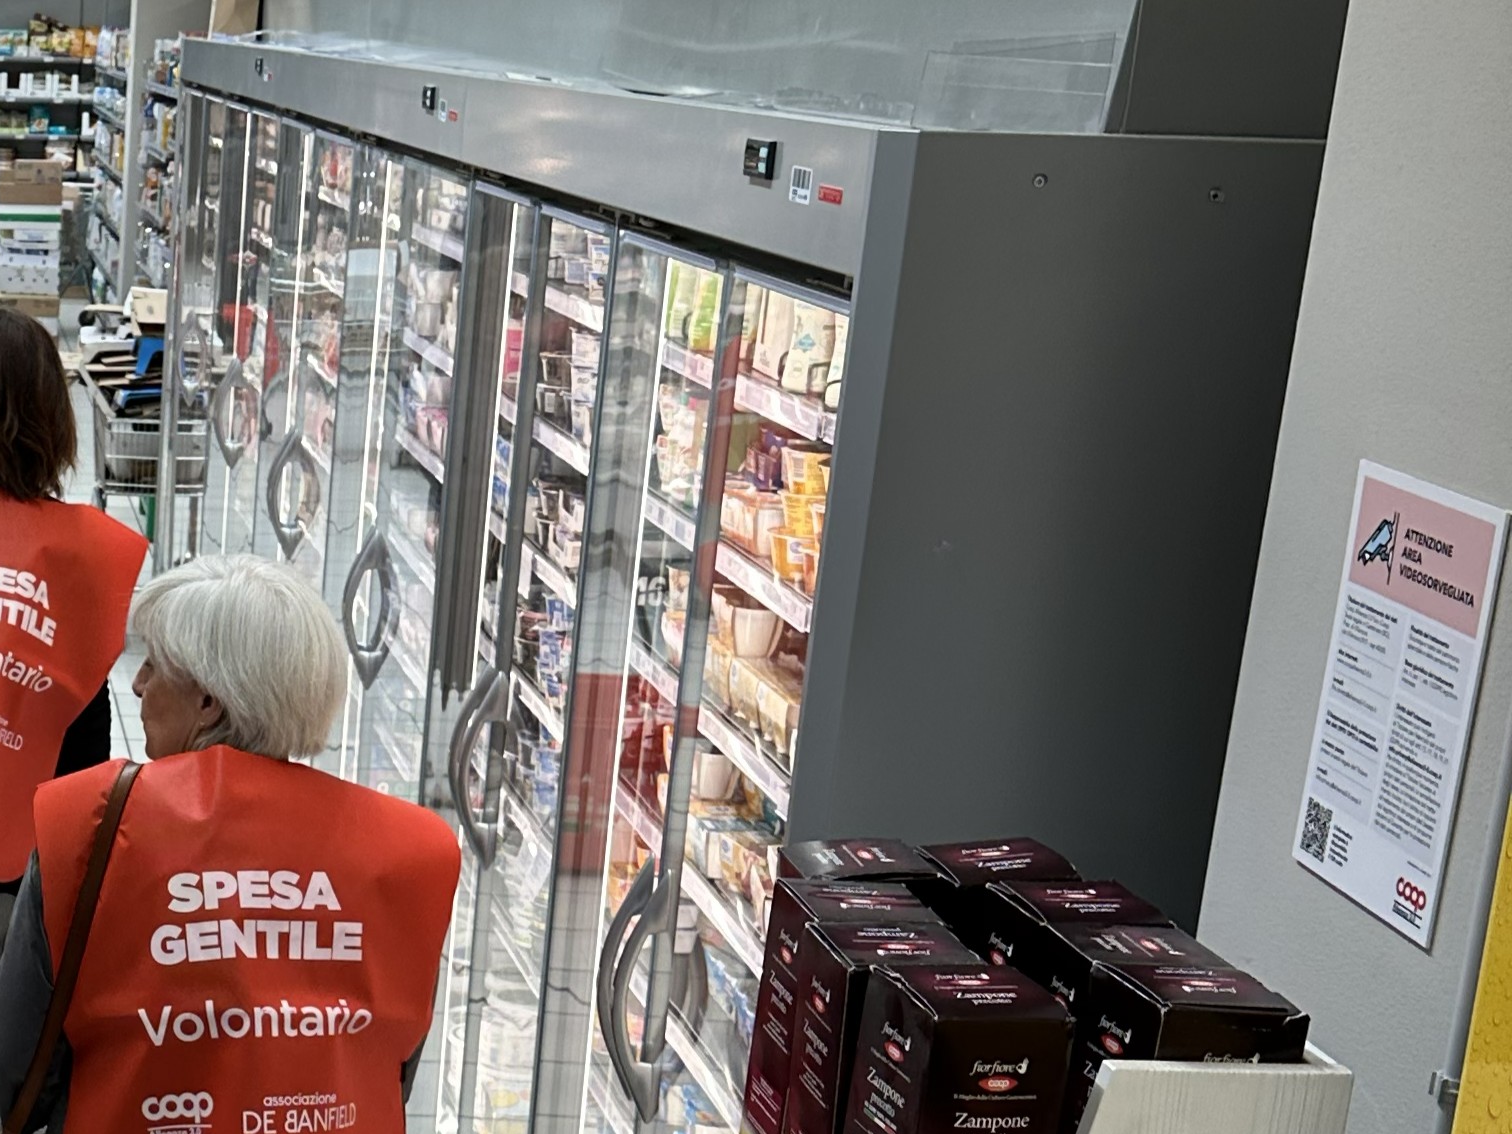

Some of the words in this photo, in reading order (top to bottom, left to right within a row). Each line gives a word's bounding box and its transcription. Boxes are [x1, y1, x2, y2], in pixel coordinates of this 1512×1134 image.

[1401, 547, 1422, 565] AREA
[1404, 528, 1454, 558] ATTENZIONE
[1399, 565, 1474, 607] VIDEOSORVEGLIATA
[167, 870, 342, 913] SPESA
[1396, 876, 1426, 912] coop
[150, 919, 363, 966] GENTILE
[138, 999, 372, 1047] Volontario
[263, 1092, 337, 1107] associazione
[866, 1066, 906, 1110] Zampone
[141, 1091, 214, 1124] coop
[242, 1110, 277, 1134] DE
[284, 1102, 356, 1134] BANFIELD
[953, 1112, 1030, 1133] Zampone
